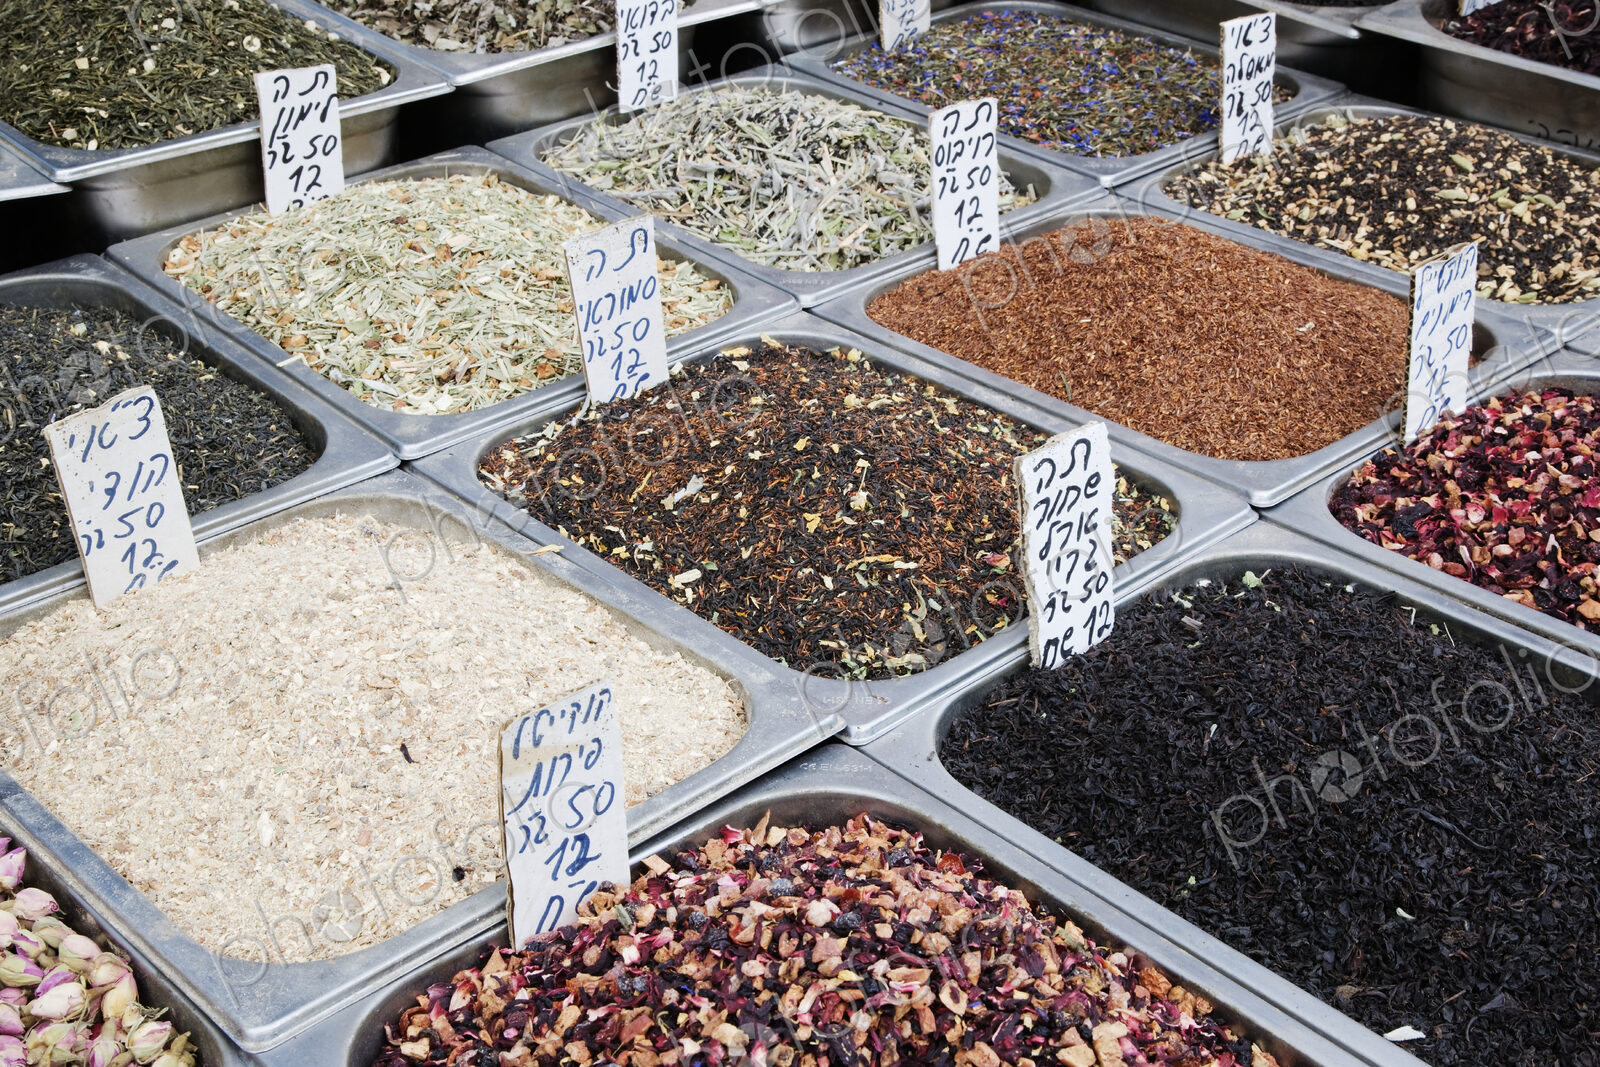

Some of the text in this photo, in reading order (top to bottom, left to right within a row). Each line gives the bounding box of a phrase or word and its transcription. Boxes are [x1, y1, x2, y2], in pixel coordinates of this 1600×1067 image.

[899, 9, 915, 28] 12
[649, 30, 672, 53] 50
[636, 59, 659, 82] 12
[1250, 80, 1271, 107] 50
[268, 93, 338, 148] לימון
[1237, 110, 1263, 136] 12
[303, 134, 338, 160] 50
[935, 132, 995, 167] רויבוס
[288, 164, 322, 192] 12
[966, 164, 992, 189] 50
[954, 195, 983, 229] 12
[579, 275, 656, 333] סמוראי
[1415, 289, 1472, 341] רימונים
[610, 317, 650, 350] 50
[1442, 323, 1468, 360] 50
[610, 348, 648, 381] 12
[1425, 364, 1449, 397] 12
[1033, 471, 1102, 531] שחור
[113, 502, 165, 539] 50
[120, 538, 165, 574] 12
[1080, 571, 1109, 604] 50
[1083, 600, 1111, 645] 12
[507, 737, 603, 816] פירות
[565, 780, 615, 829] 50
[544, 832, 602, 881] 12
